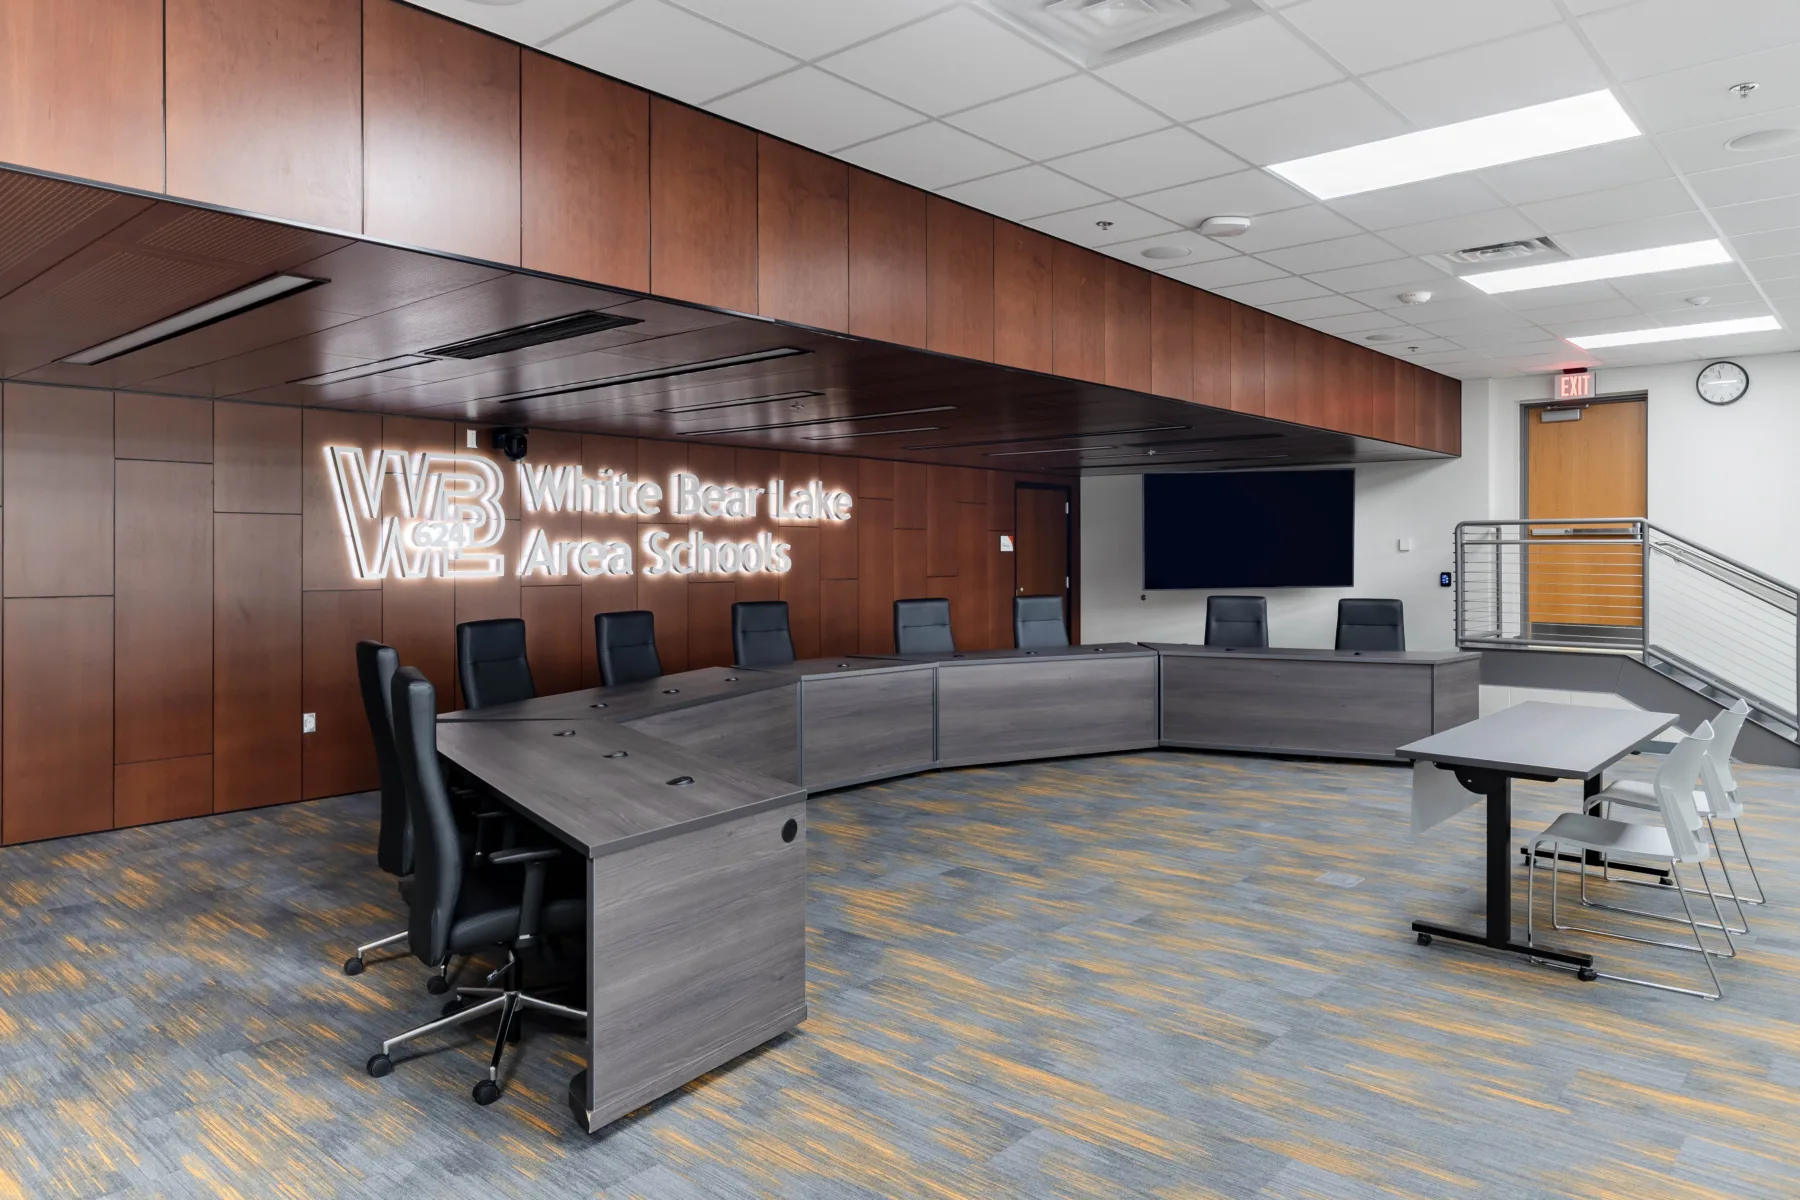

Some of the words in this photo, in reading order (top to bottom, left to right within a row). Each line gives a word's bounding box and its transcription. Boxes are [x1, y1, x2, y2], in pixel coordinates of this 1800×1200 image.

[1561, 375, 1590, 397] EXIT
[522, 463, 663, 514] White
[678, 473, 765, 517] Bear
[775, 479, 852, 520] Lake
[411, 522, 466, 547] 624
[521, 529, 634, 575] Area
[643, 531, 792, 575] Schools
